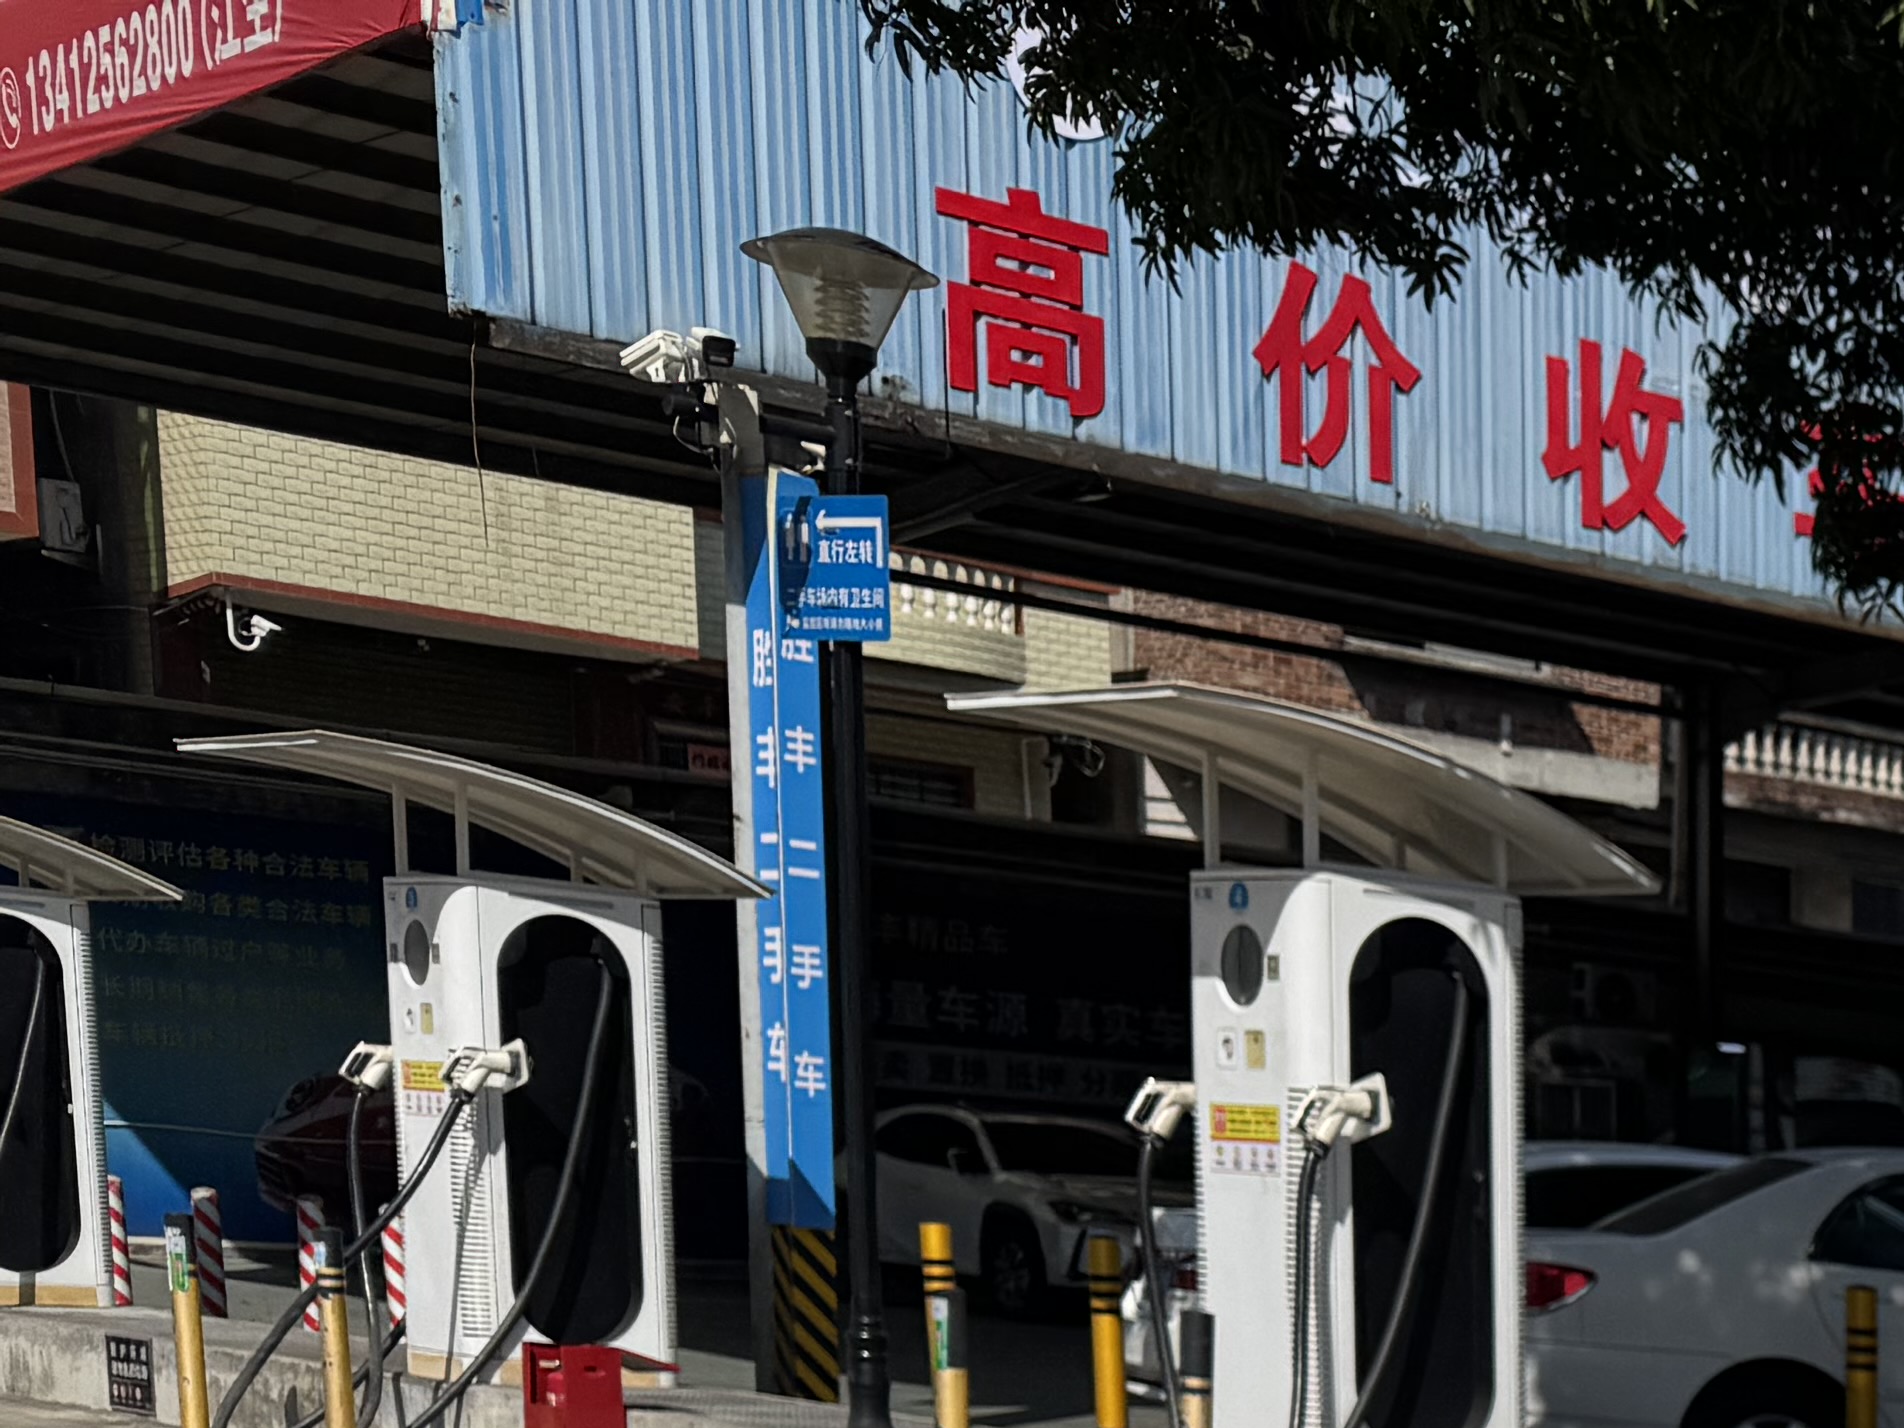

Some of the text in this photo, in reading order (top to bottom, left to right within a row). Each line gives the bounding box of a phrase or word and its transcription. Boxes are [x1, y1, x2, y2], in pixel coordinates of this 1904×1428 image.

[26, 0, 194, 135] 13412562800
[817, 539, 874, 564] 直行左转
